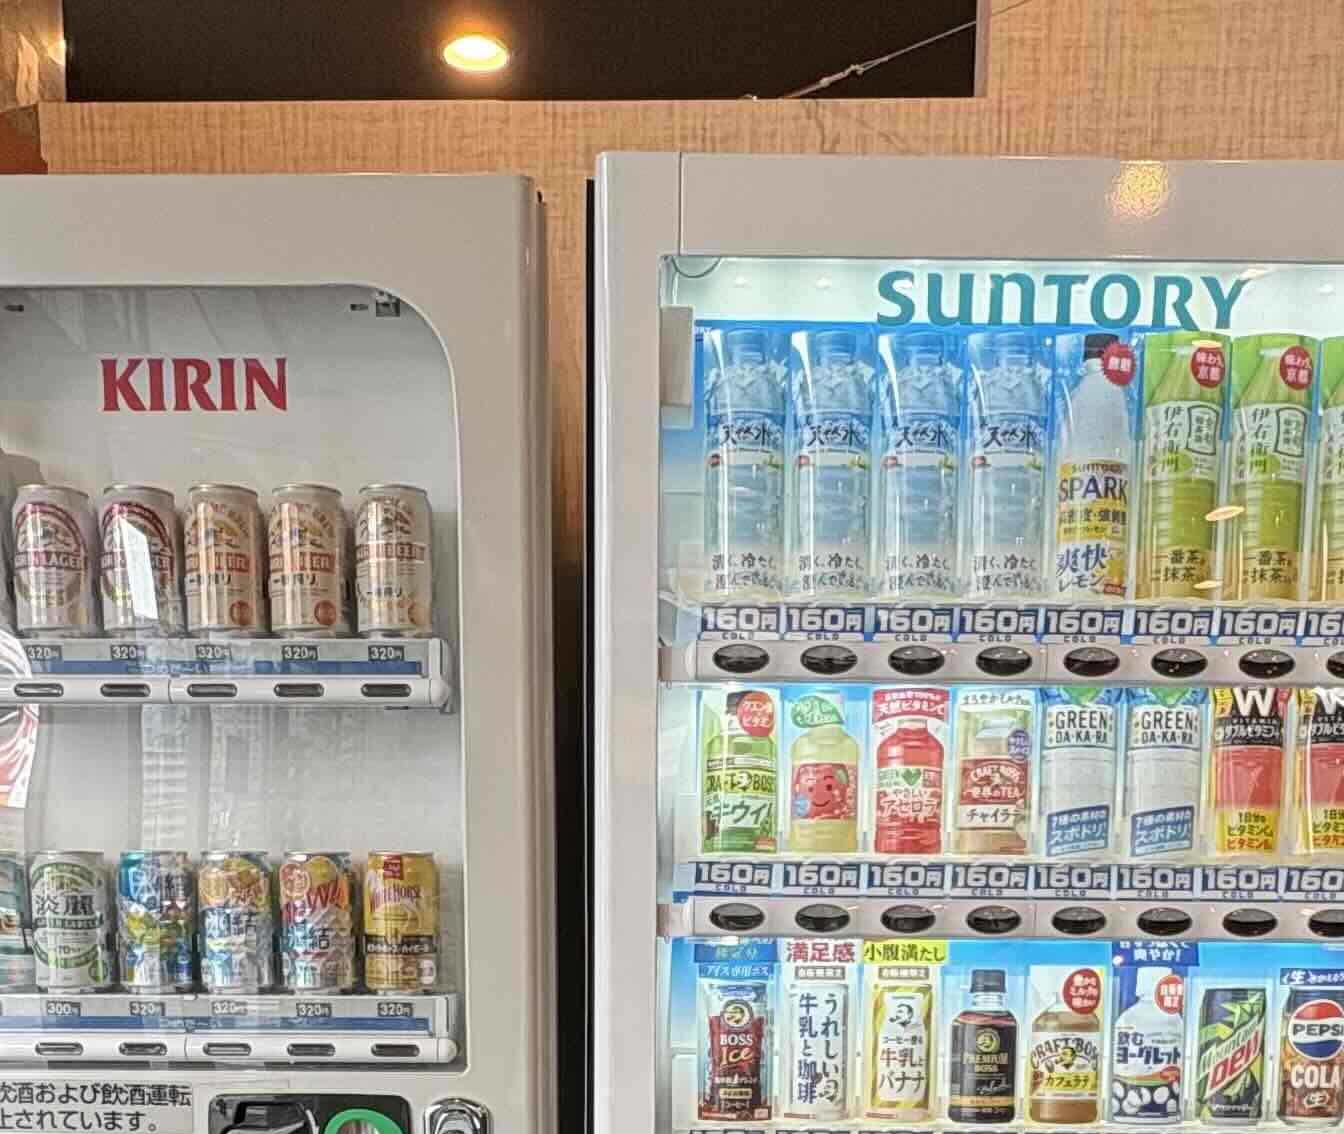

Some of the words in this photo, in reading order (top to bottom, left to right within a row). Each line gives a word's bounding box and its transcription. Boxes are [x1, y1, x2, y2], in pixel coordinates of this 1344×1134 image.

[876, 270, 1251, 331] SUNTORY
[101, 357, 287, 411] KIRIN
[702, 609, 778, 632] 160円
[788, 609, 862, 632] 160円
[879, 610, 951, 633] 160円
[962, 610, 1038, 633] 160円
[1047, 611, 1120, 635] 160円
[1136, 612, 1211, 635] 160円
[1222, 613, 1298, 636] 160円
[1056, 711, 1107, 730] GREEN
[1142, 711, 1194, 730] GREEN
[699, 865, 770, 884] 160円
[787, 866, 858, 885] 160円
[872, 866, 942, 887] 160円
[957, 867, 1025, 888] 160円
[1037, 869, 1106, 888] 160円
[1122, 869, 1190, 889] 160円
[1207, 870, 1278, 890] 160円
[787, 942, 856, 962] 満足感
[864, 943, 946, 962] 小腹満たし
[720, 1033, 753, 1046] BOSS
[1291, 1064, 1343, 1089] COLA
